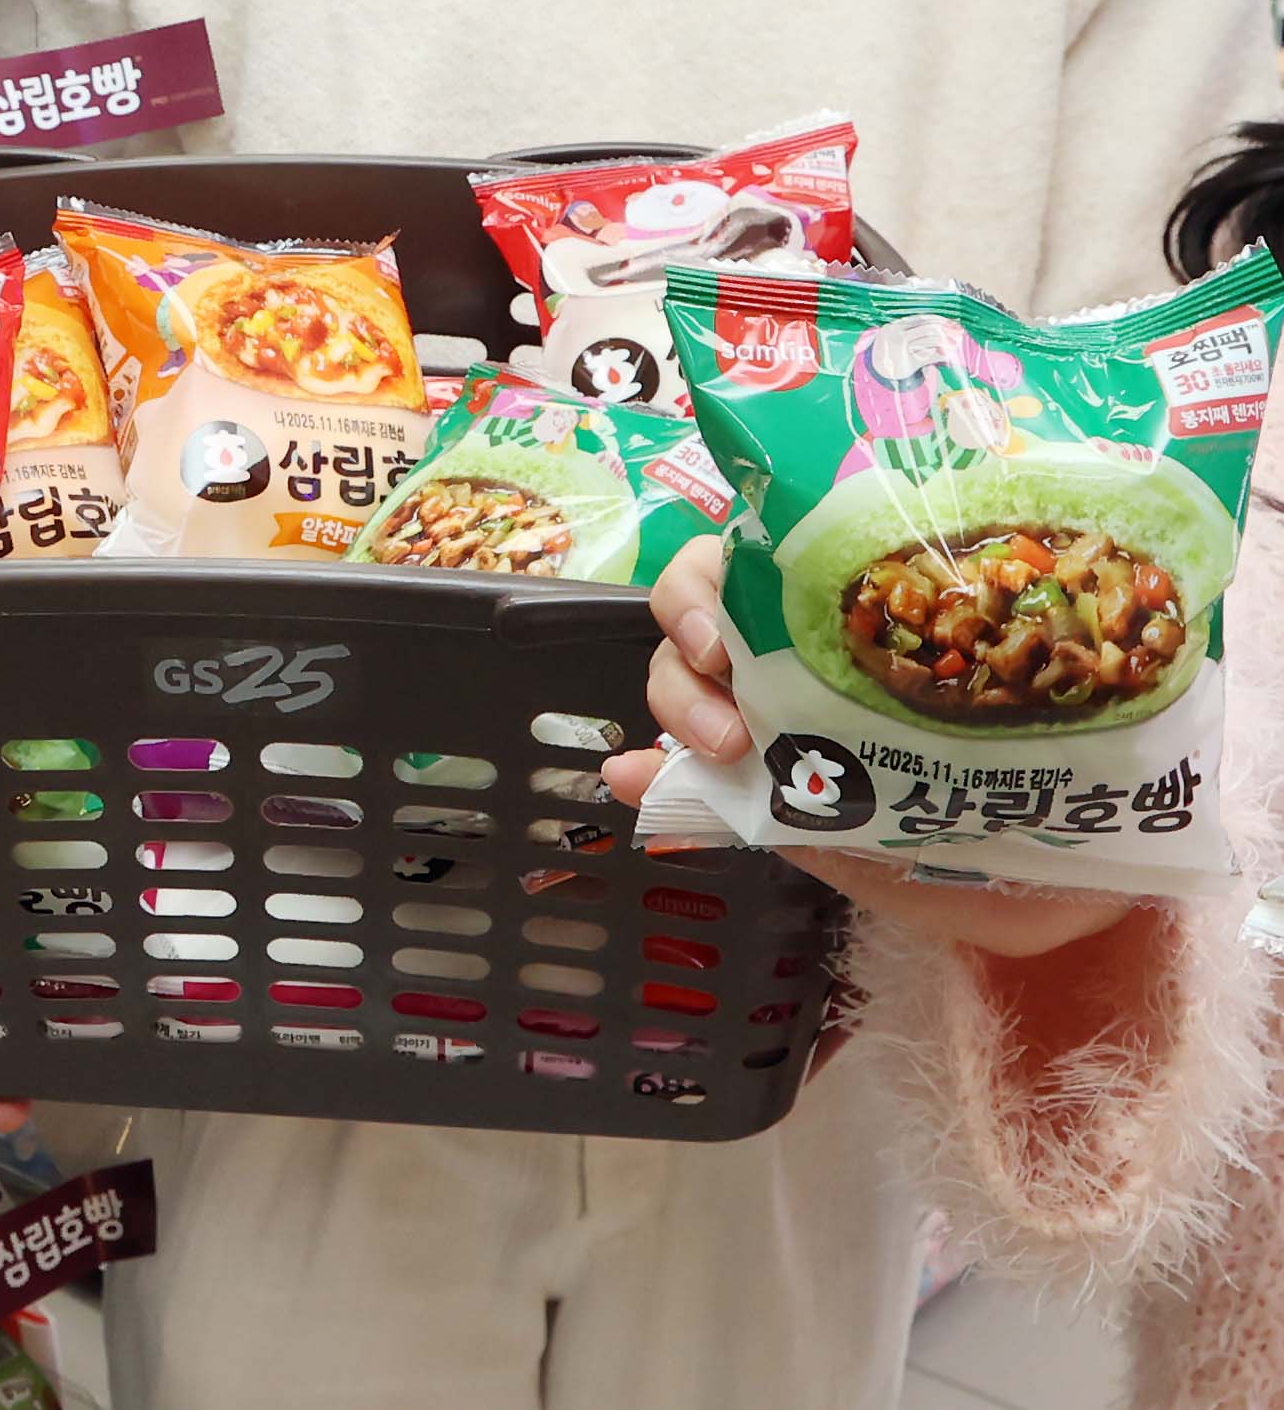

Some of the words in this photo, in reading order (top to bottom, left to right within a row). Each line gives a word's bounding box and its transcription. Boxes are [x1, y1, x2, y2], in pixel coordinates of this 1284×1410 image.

[720, 340, 816, 365] samlip
[1173, 369, 1211, 396] 30
[153, 643, 351, 713] GS25
[858, 740, 1026, 790] 나2025.11.16까지E
[1029, 766, 1075, 789] 김기수
